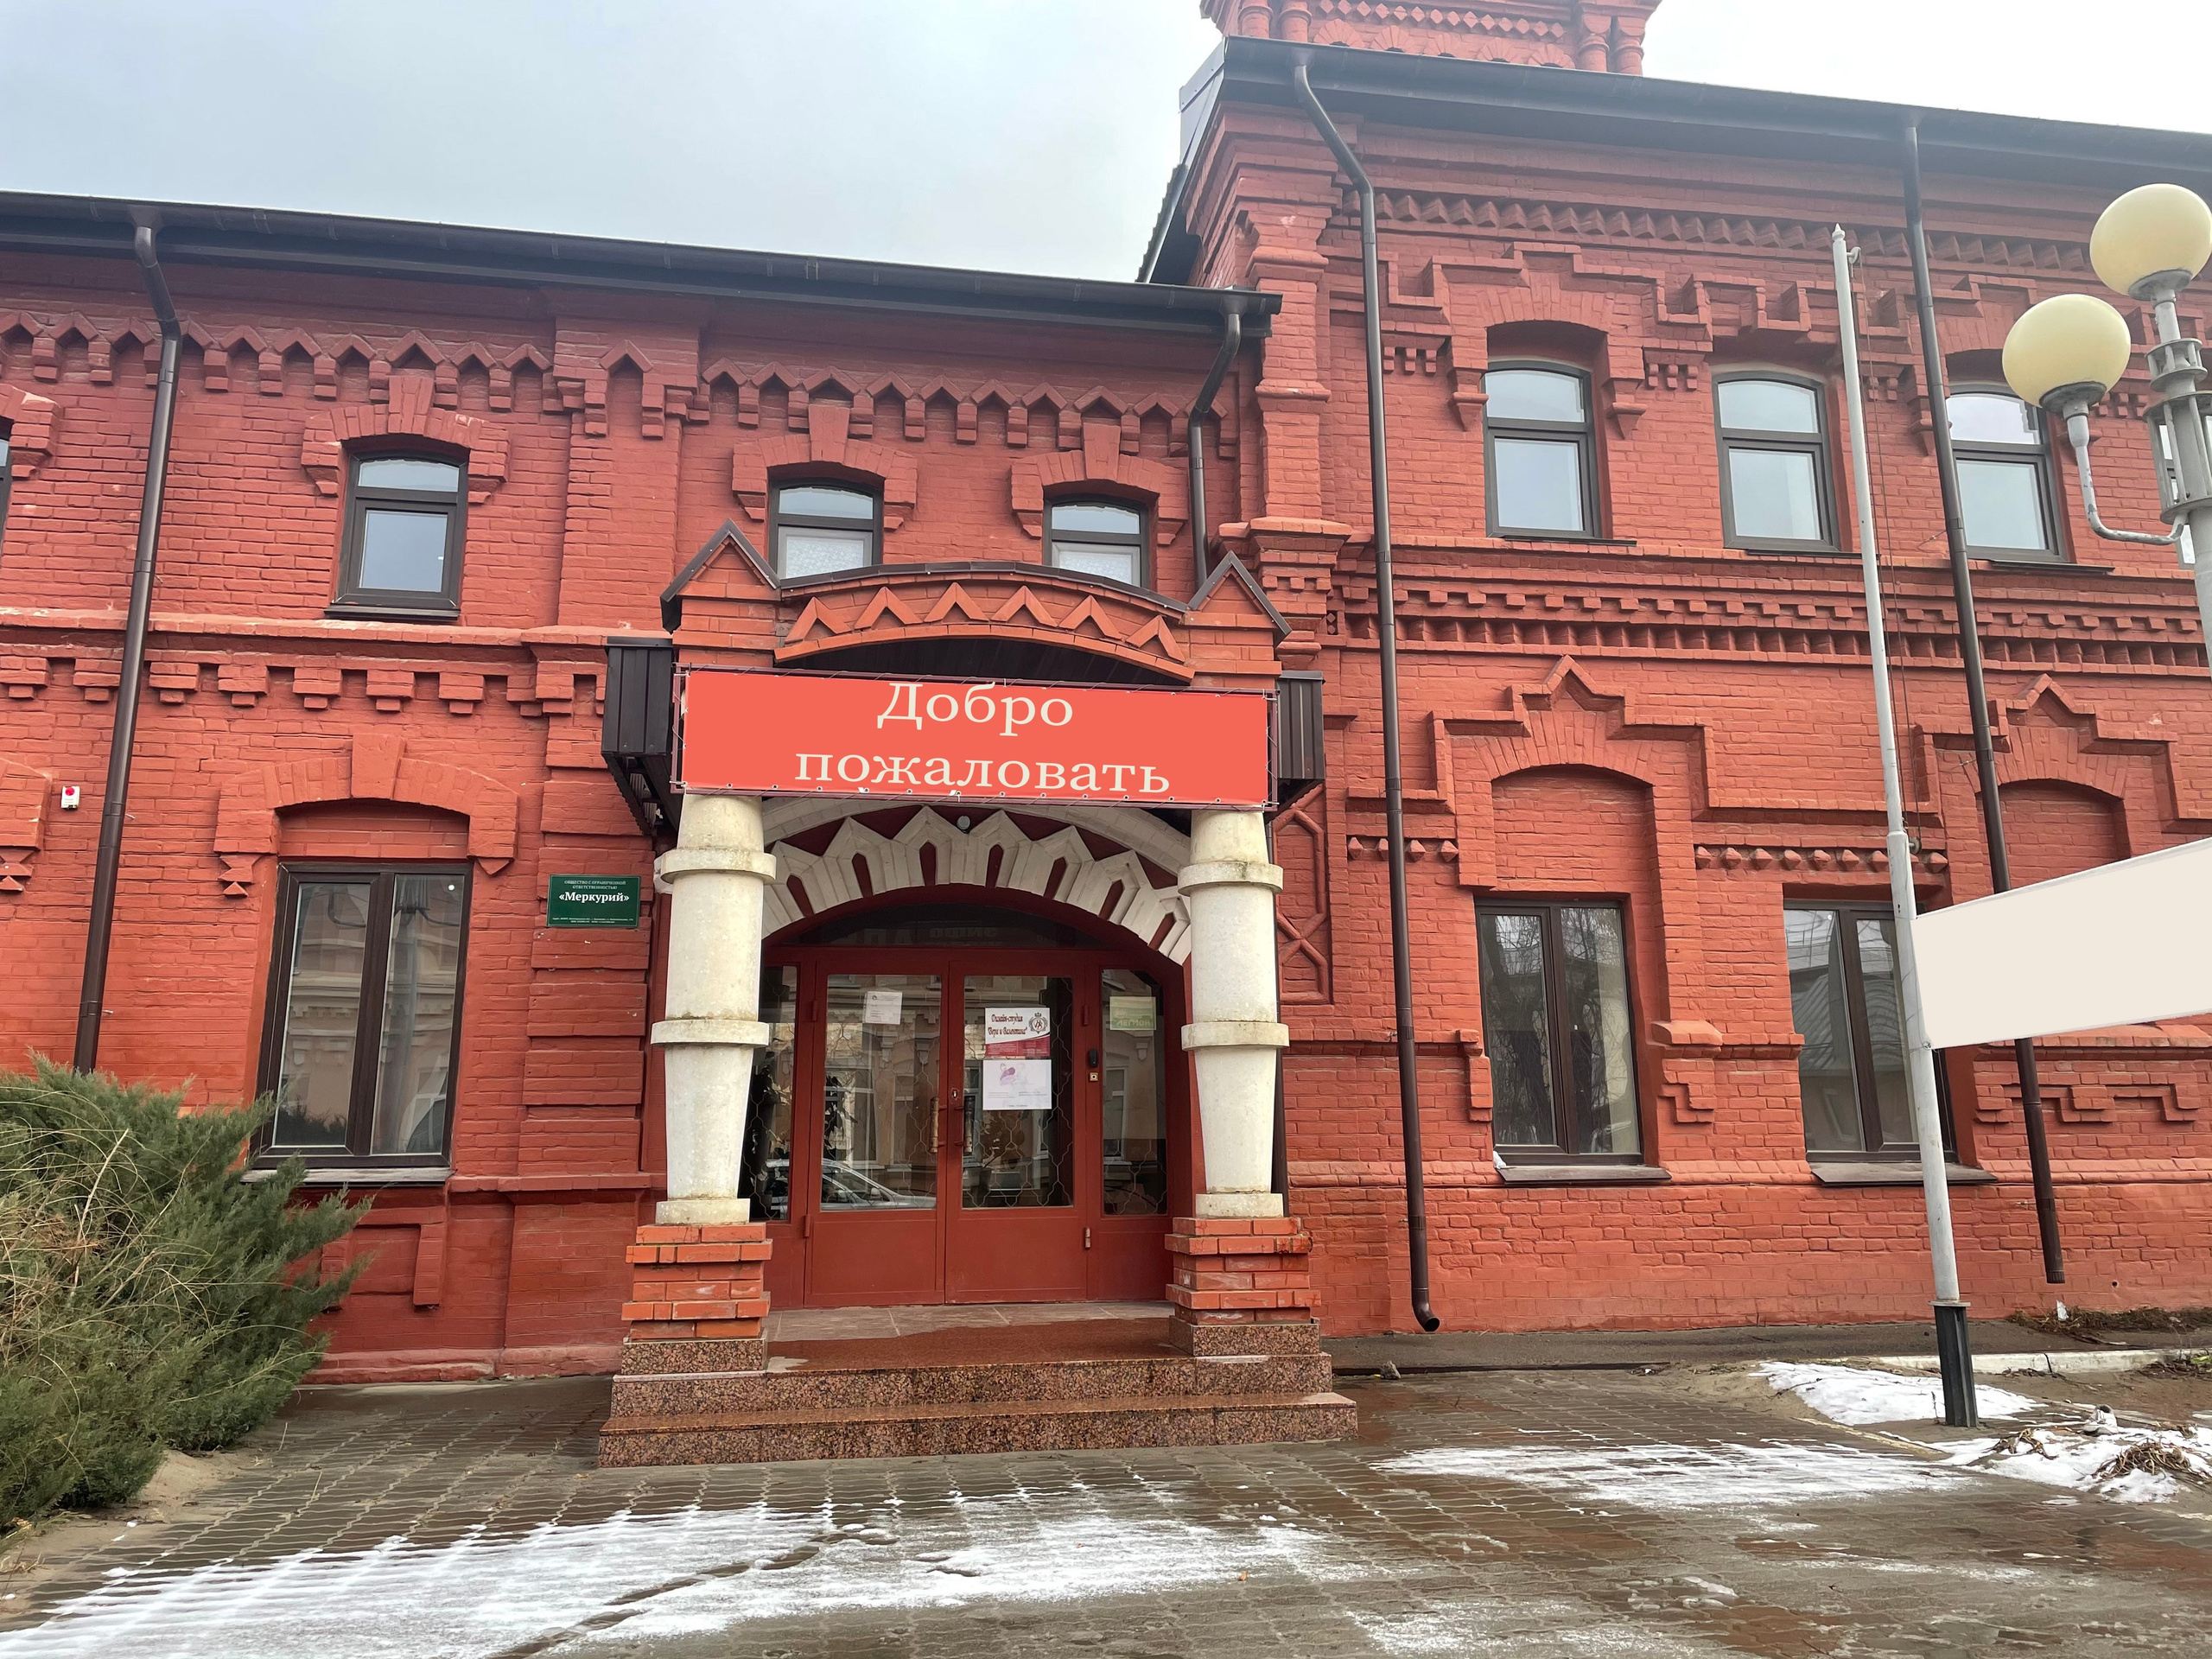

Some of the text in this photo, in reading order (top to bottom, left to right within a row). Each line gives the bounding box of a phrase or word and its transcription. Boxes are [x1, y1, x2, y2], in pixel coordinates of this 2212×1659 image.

[877, 681, 1073, 737] Добро
[794, 753, 1171, 793] пожаловать
[558, 891, 630, 904] «Меркурий»
